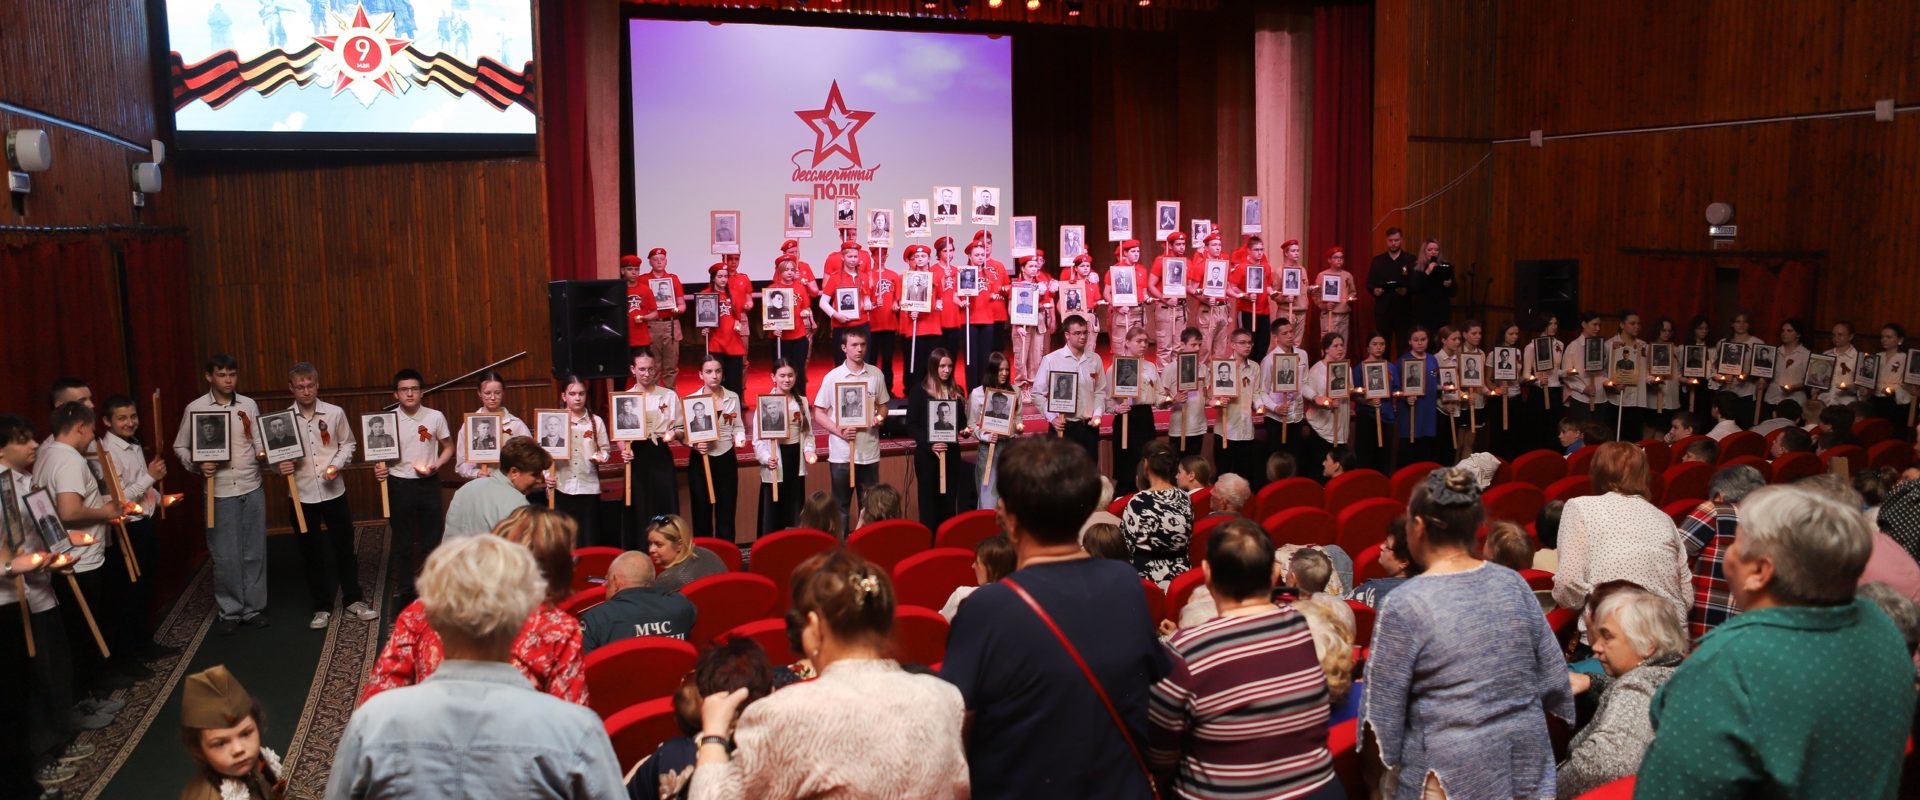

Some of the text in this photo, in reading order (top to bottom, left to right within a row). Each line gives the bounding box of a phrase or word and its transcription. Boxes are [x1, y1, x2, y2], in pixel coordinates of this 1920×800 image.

[355, 39, 371, 62] 9
[792, 149, 880, 185] бессмертный
[814, 183, 860, 200] ПОЛК
[634, 621, 672, 638] МЧС
